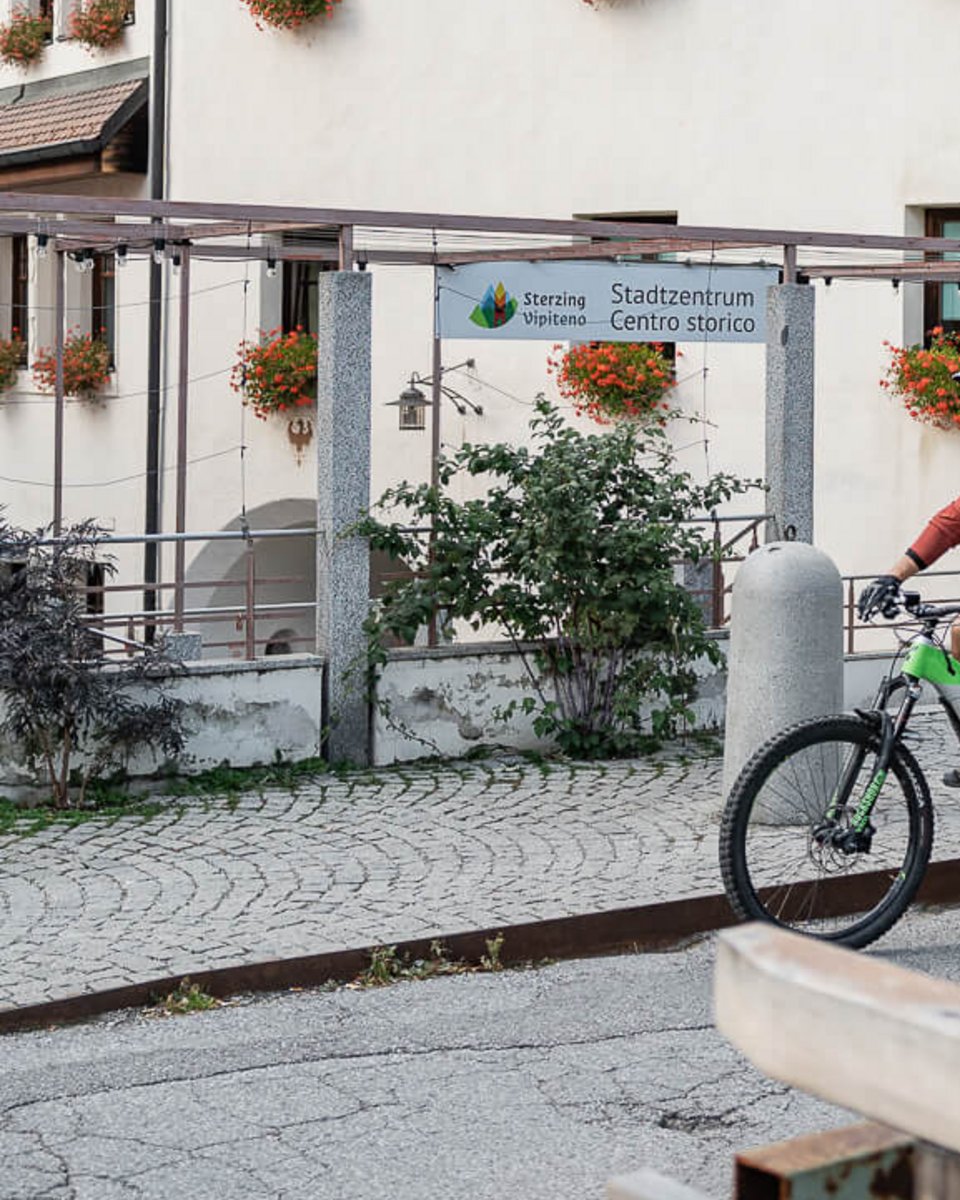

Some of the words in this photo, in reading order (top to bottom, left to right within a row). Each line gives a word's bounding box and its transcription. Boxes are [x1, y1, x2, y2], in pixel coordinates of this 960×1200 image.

[523, 291, 586, 311] Sterzing
[611, 282, 755, 308] Stadtzentrum
[523, 310, 587, 328] Vipiteno
[610, 309, 680, 331] Centro
[686, 311, 755, 333] storico
